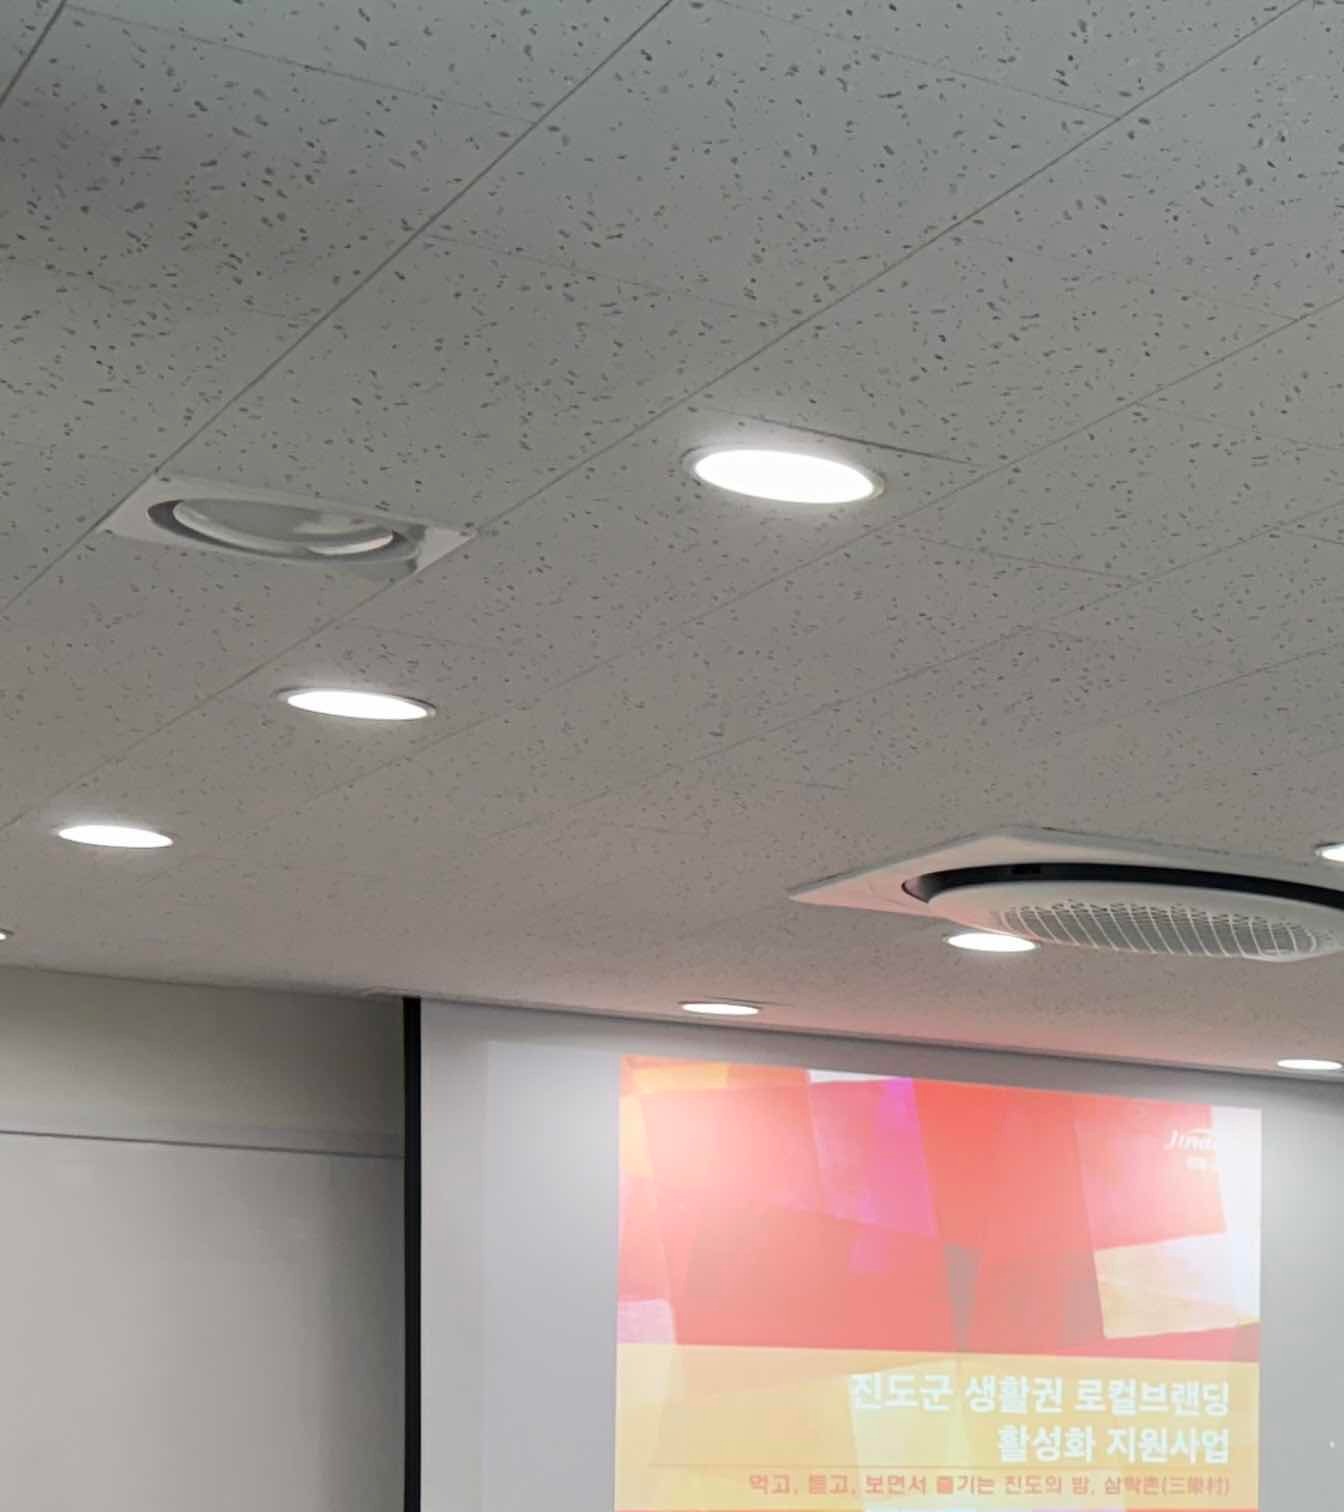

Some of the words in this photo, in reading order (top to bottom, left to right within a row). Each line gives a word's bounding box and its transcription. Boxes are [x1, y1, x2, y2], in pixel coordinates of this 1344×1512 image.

[849, 1373, 954, 1412] 진도군
[965, 1375, 1064, 1415] 생활권
[1074, 1378, 1230, 1416] 로컬브랜딩
[998, 1423, 1096, 1464] 활성화
[1106, 1426, 1230, 1465] 지원사업
[865, 1474, 927, 1496] 보면서
[1005, 1475, 1063, 1496] 진도의
